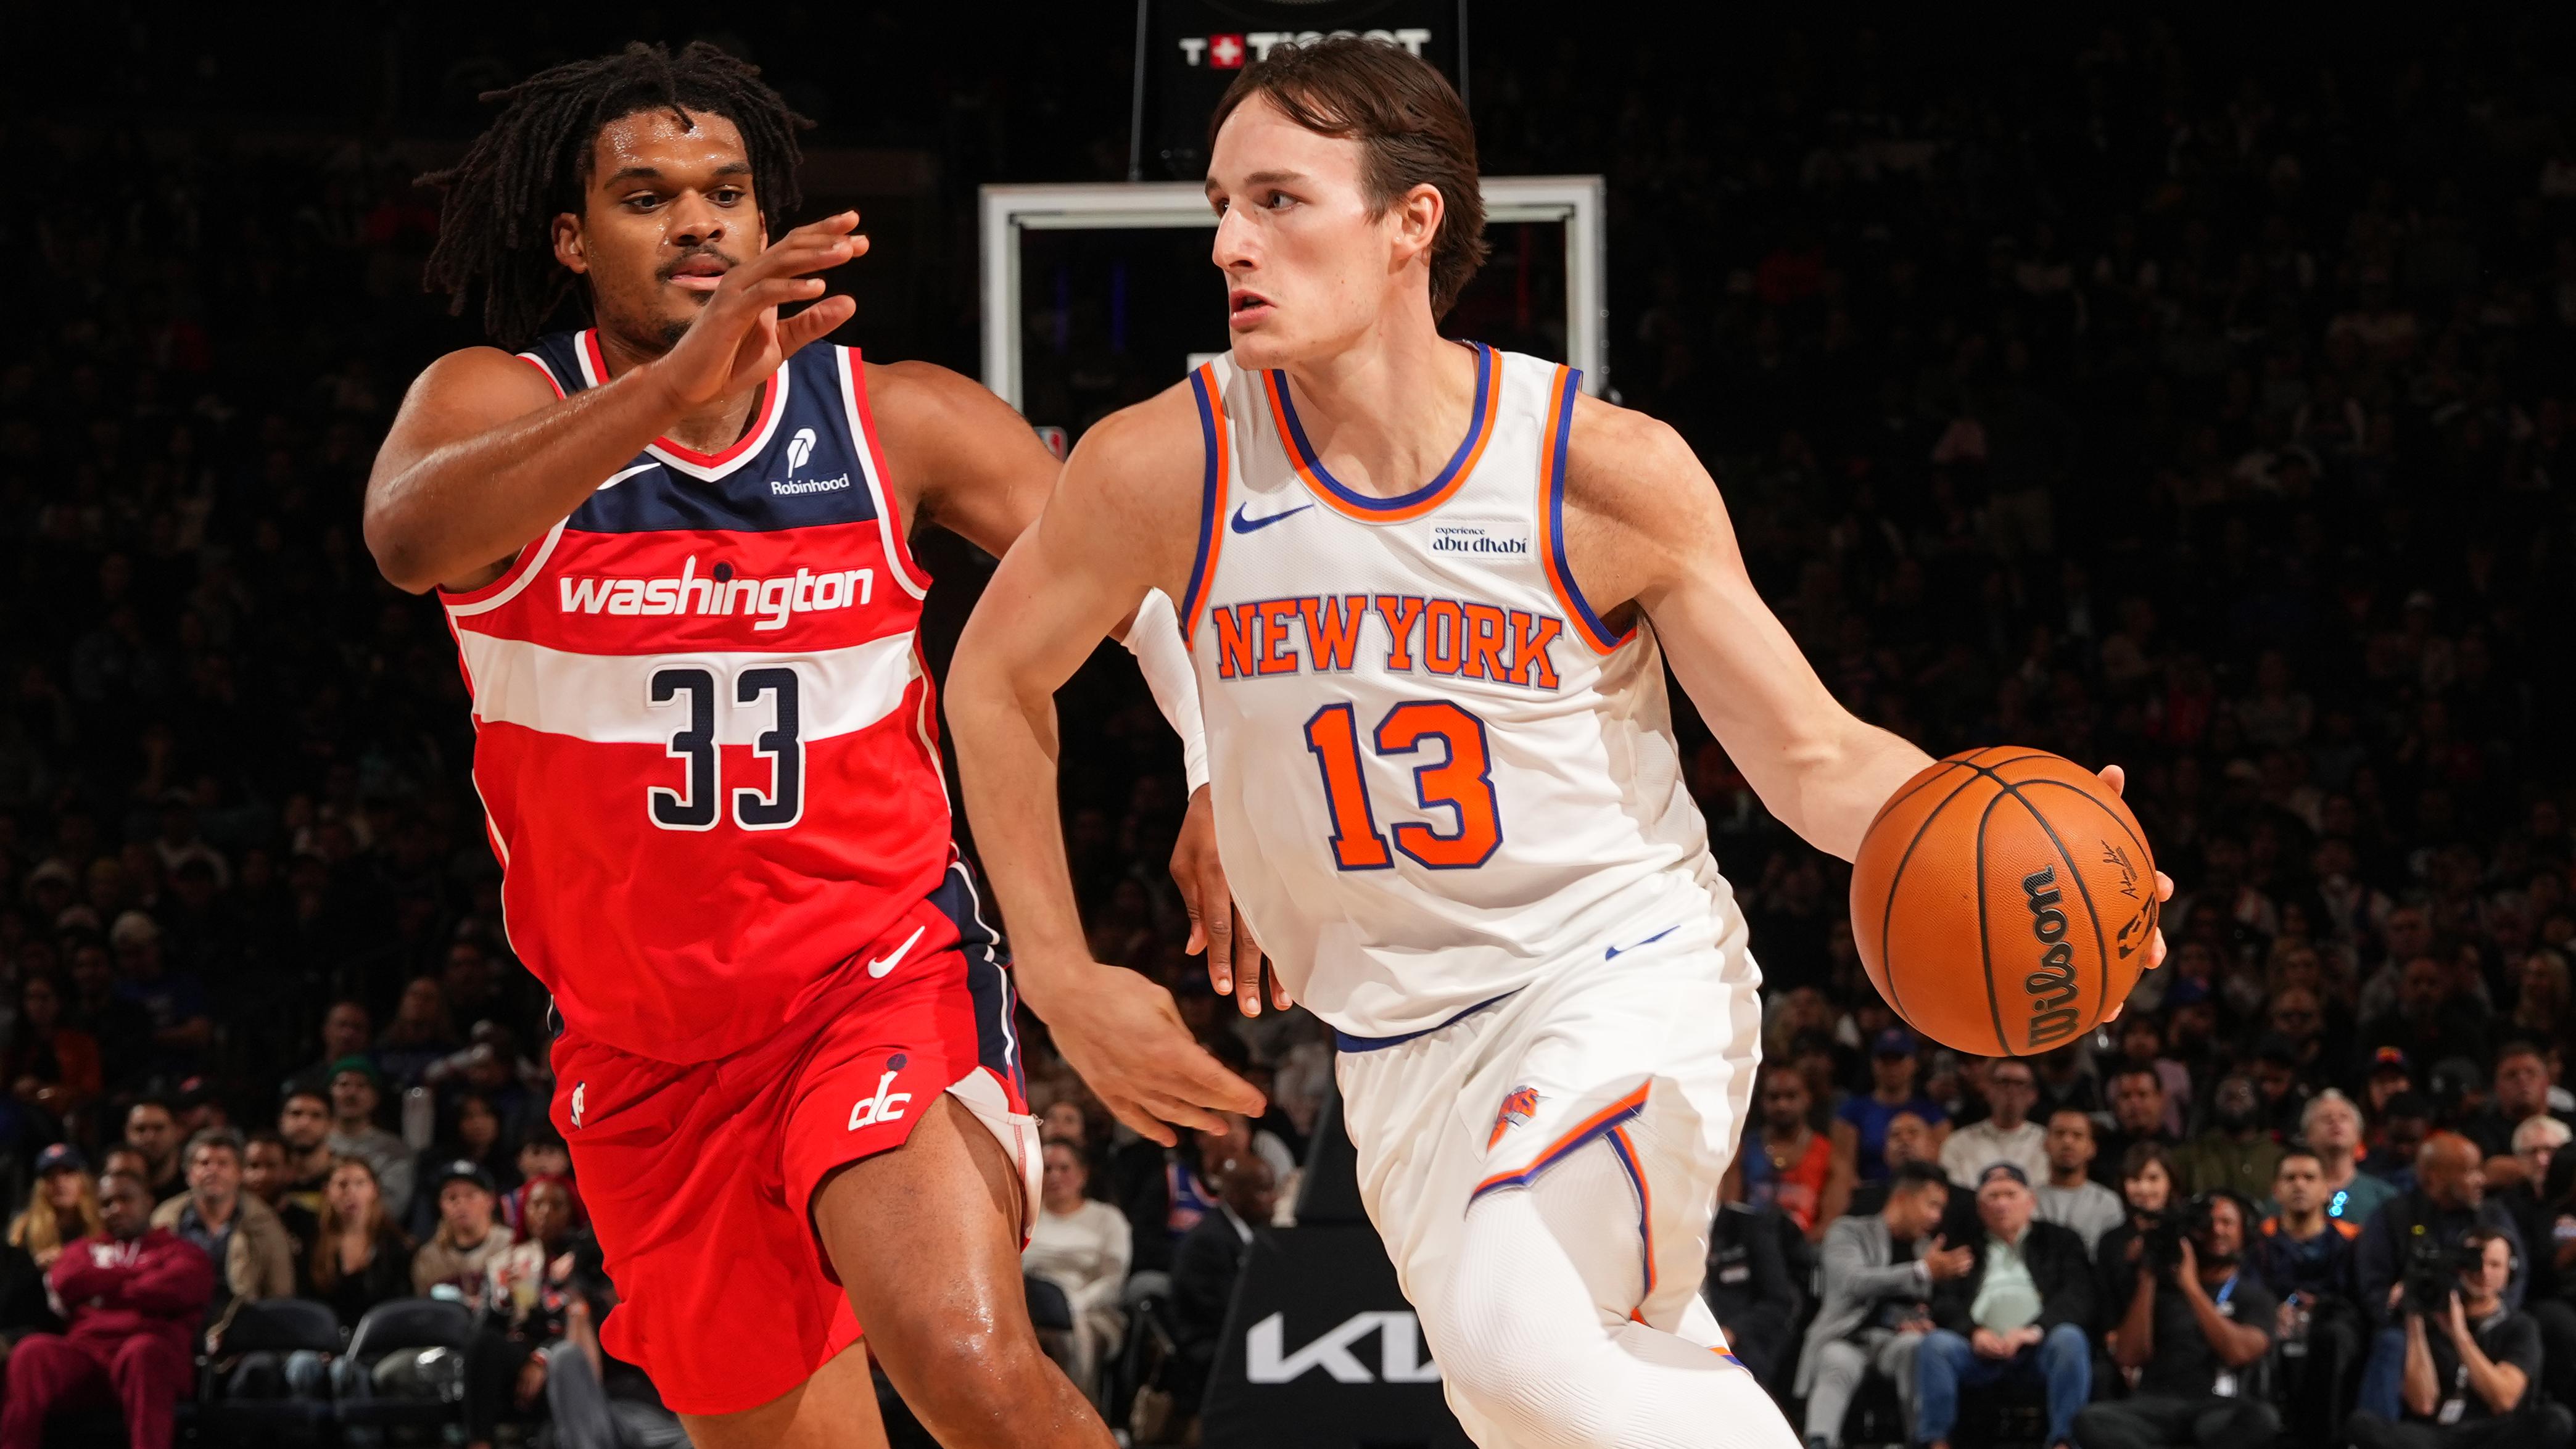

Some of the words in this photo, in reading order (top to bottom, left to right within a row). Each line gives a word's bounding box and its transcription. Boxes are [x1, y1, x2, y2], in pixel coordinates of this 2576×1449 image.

[770, 473, 850, 495] Robinhood
[1433, 536, 1469, 552] abu
[1472, 537, 1527, 553] dhabi
[1435, 527, 1485, 535] experience
[559, 555, 873, 631] washington
[1211, 593, 1368, 680] NEW
[1375, 594, 1564, 692] YORK
[646, 663, 806, 832] 33
[1303, 699, 1504, 871] 13
[2021, 865, 2079, 1047] Wilson
